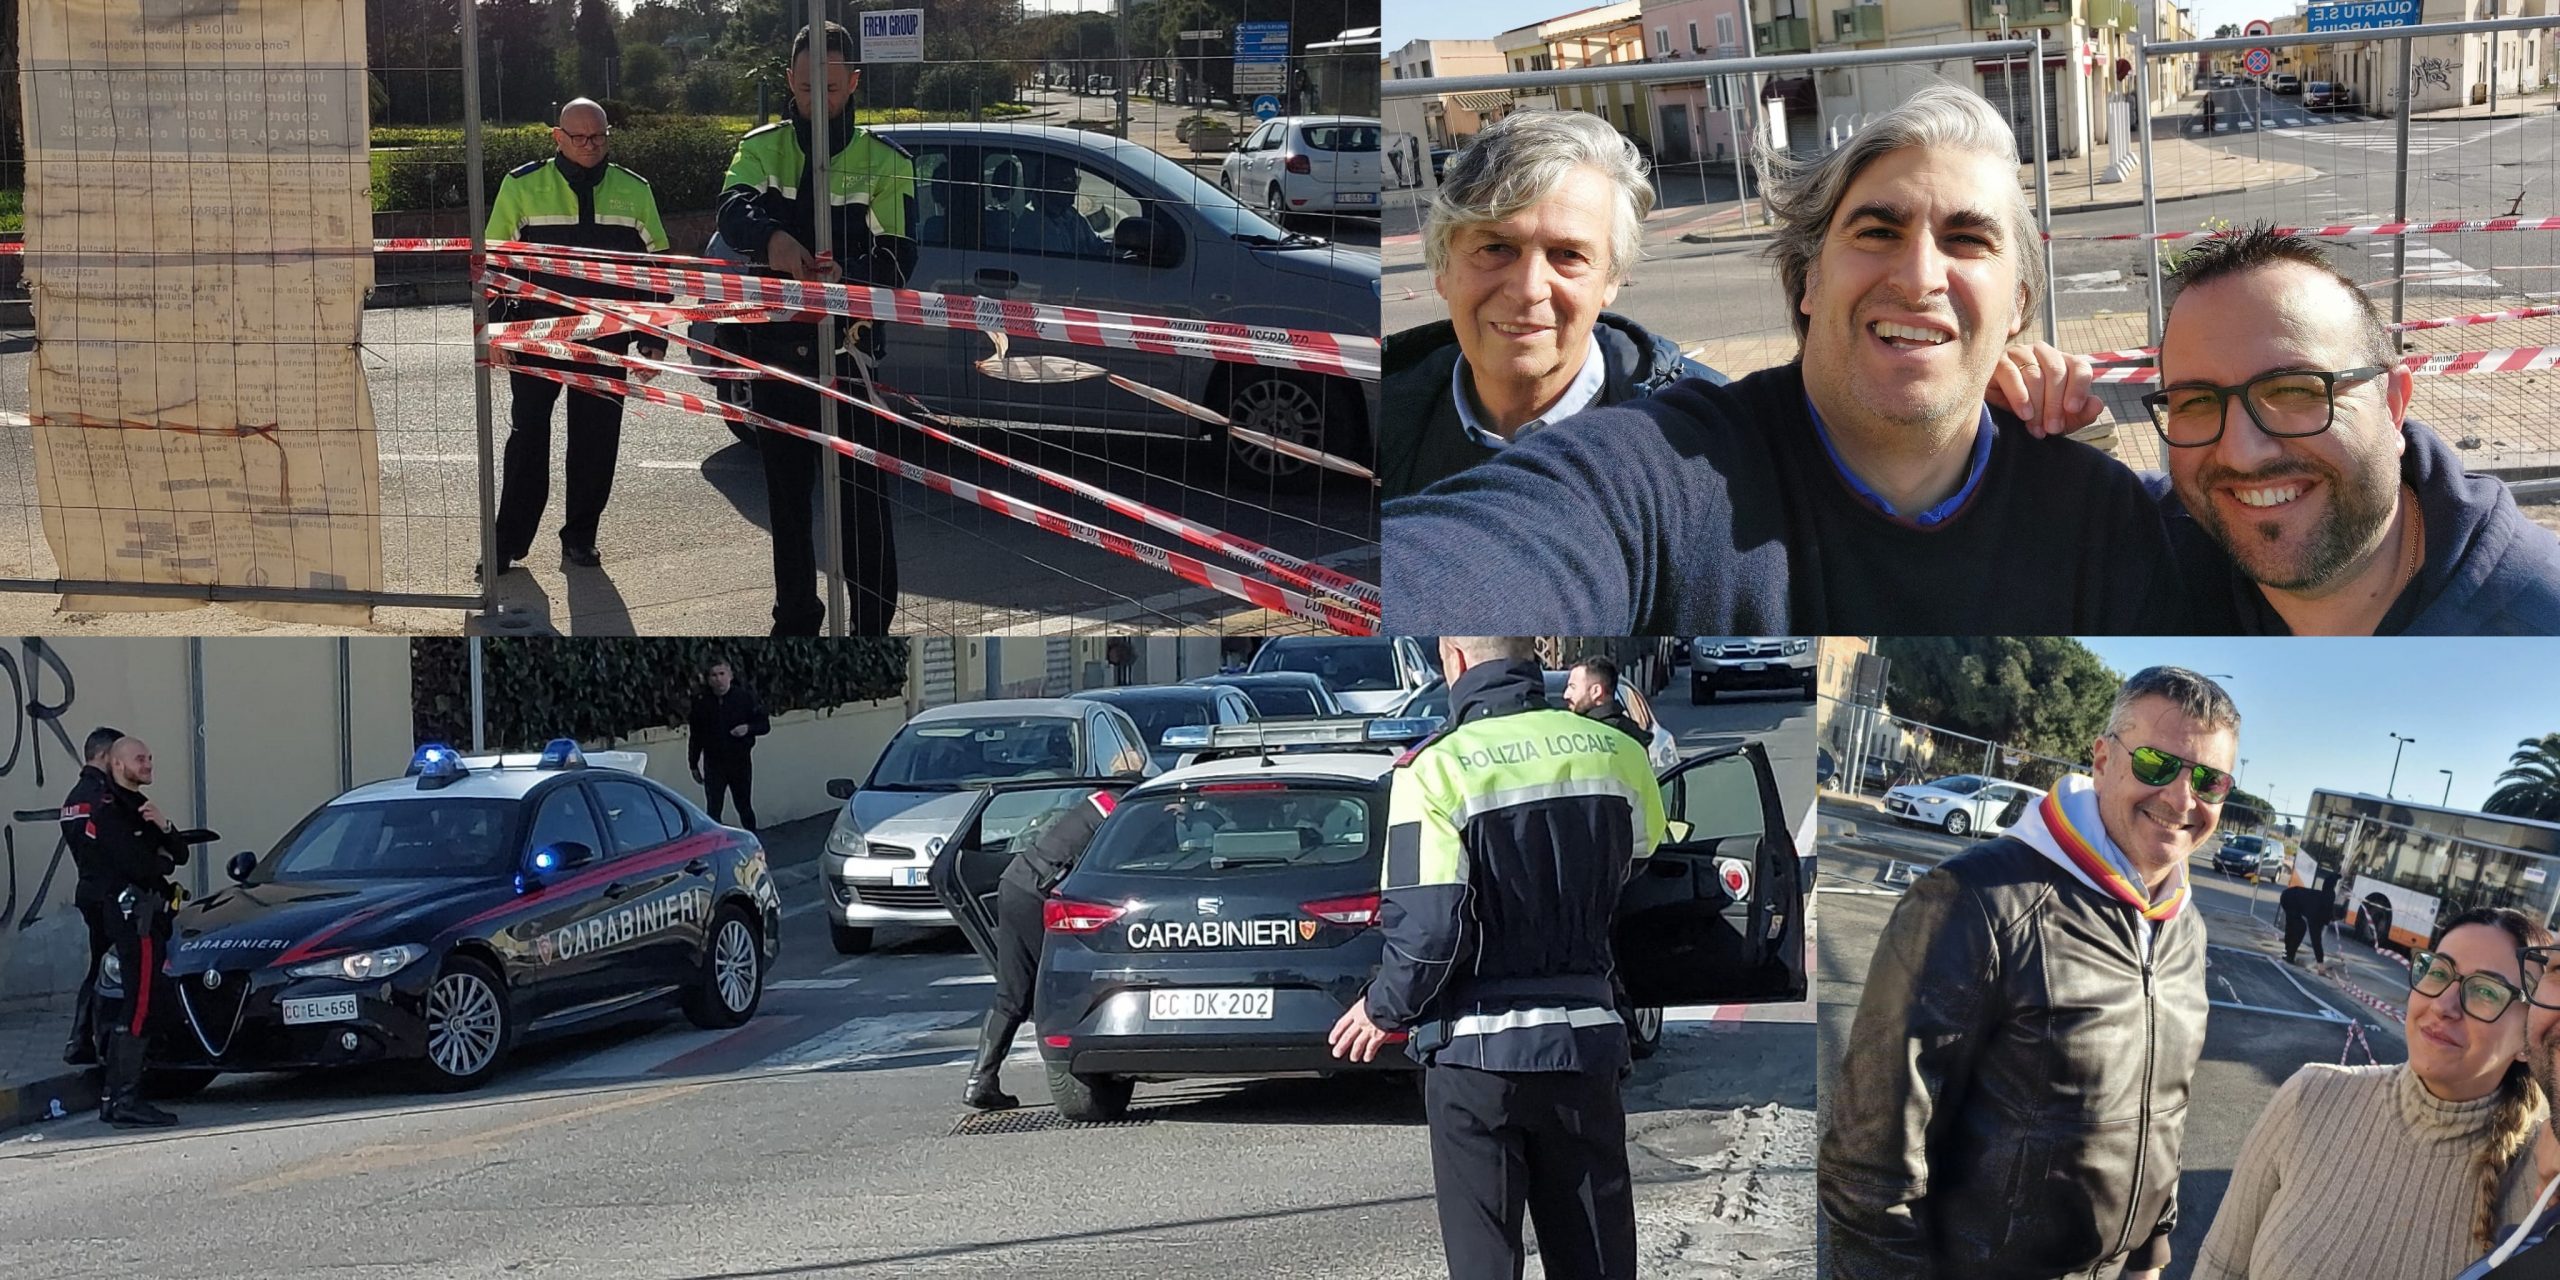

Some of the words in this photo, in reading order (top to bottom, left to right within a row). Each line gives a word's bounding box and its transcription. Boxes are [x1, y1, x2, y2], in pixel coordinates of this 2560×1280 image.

[864, 16, 887, 37] FREM
[889, 14, 918, 36] GROUP
[979, 300, 1040, 319] MONSERRATO
[1304, 597, 1357, 625] COMUNE
[1457, 740, 1541, 771] POLIZIA
[1545, 733, 1618, 756] LOCALE
[559, 888, 701, 961] CARABINIERI
[1127, 919, 1297, 948] CARABINIERI
[180, 938, 291, 952] CARABINIERI
